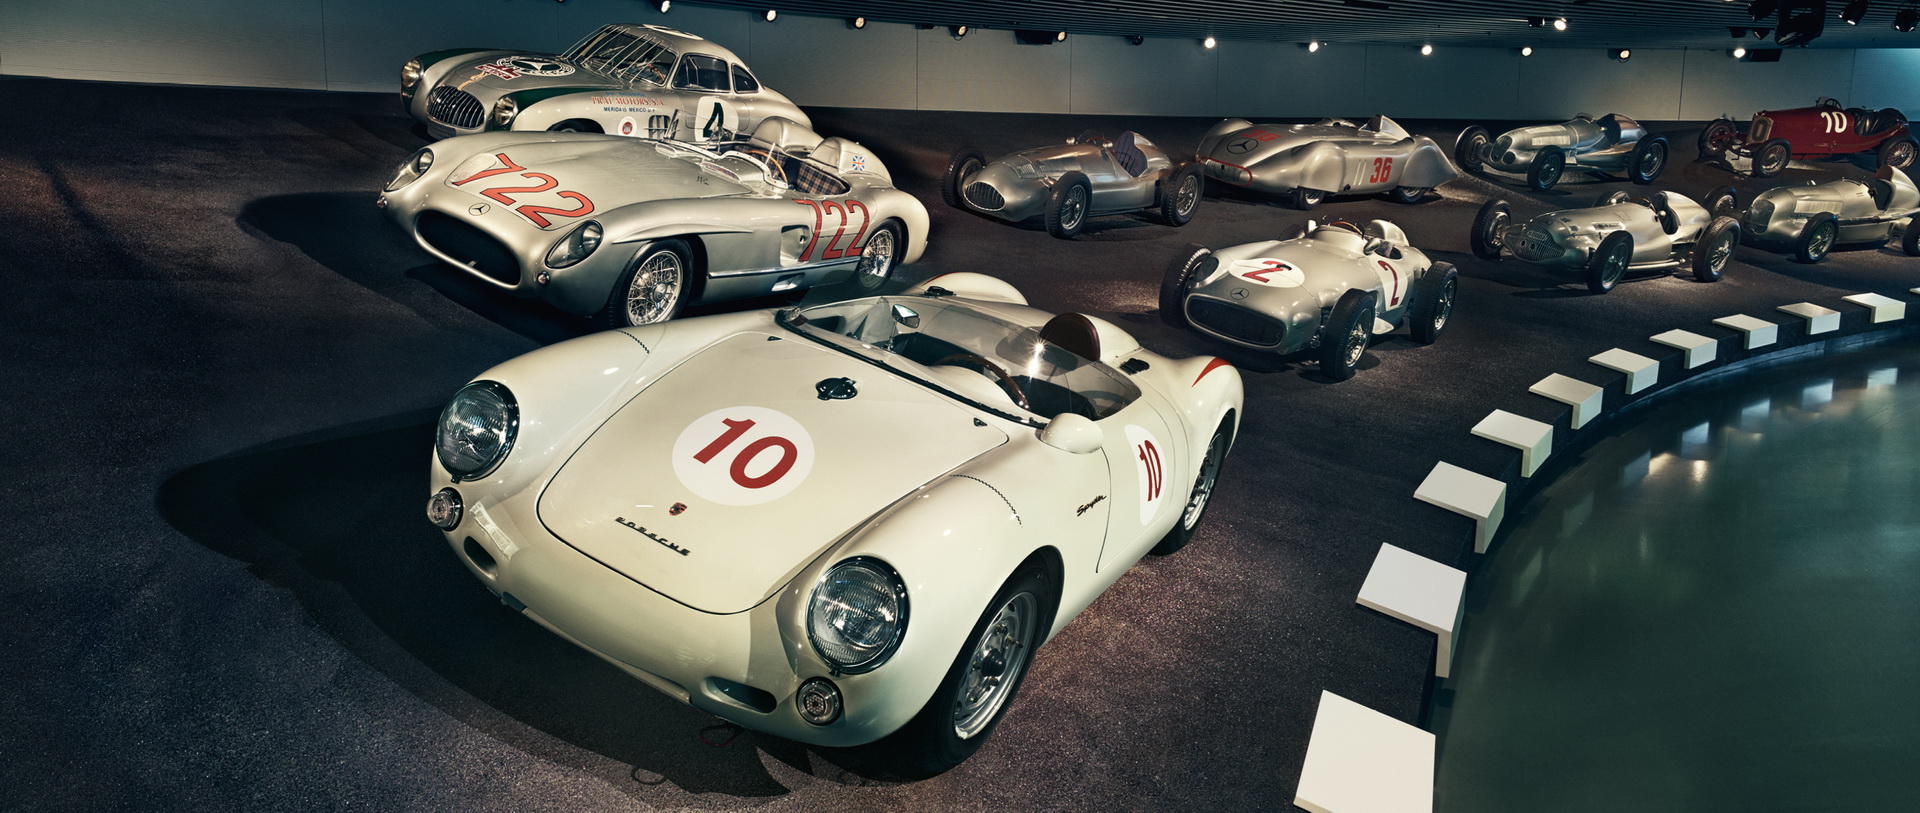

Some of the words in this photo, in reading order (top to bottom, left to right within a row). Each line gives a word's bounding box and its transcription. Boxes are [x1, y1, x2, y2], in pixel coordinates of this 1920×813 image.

[702, 102, 724, 138] 4
[1239, 129, 1283, 142] 36
[1820, 111, 1848, 134] 10
[451, 153, 595, 228] 722
[1369, 157, 1393, 183] 36
[792, 199, 870, 262] 722
[1378, 260, 1399, 307] 2
[693, 417, 798, 489] 10
[1138, 440, 1162, 502] 10
[1076, 495, 1107, 517] Spyder
[614, 516, 691, 557] PORSCHE
